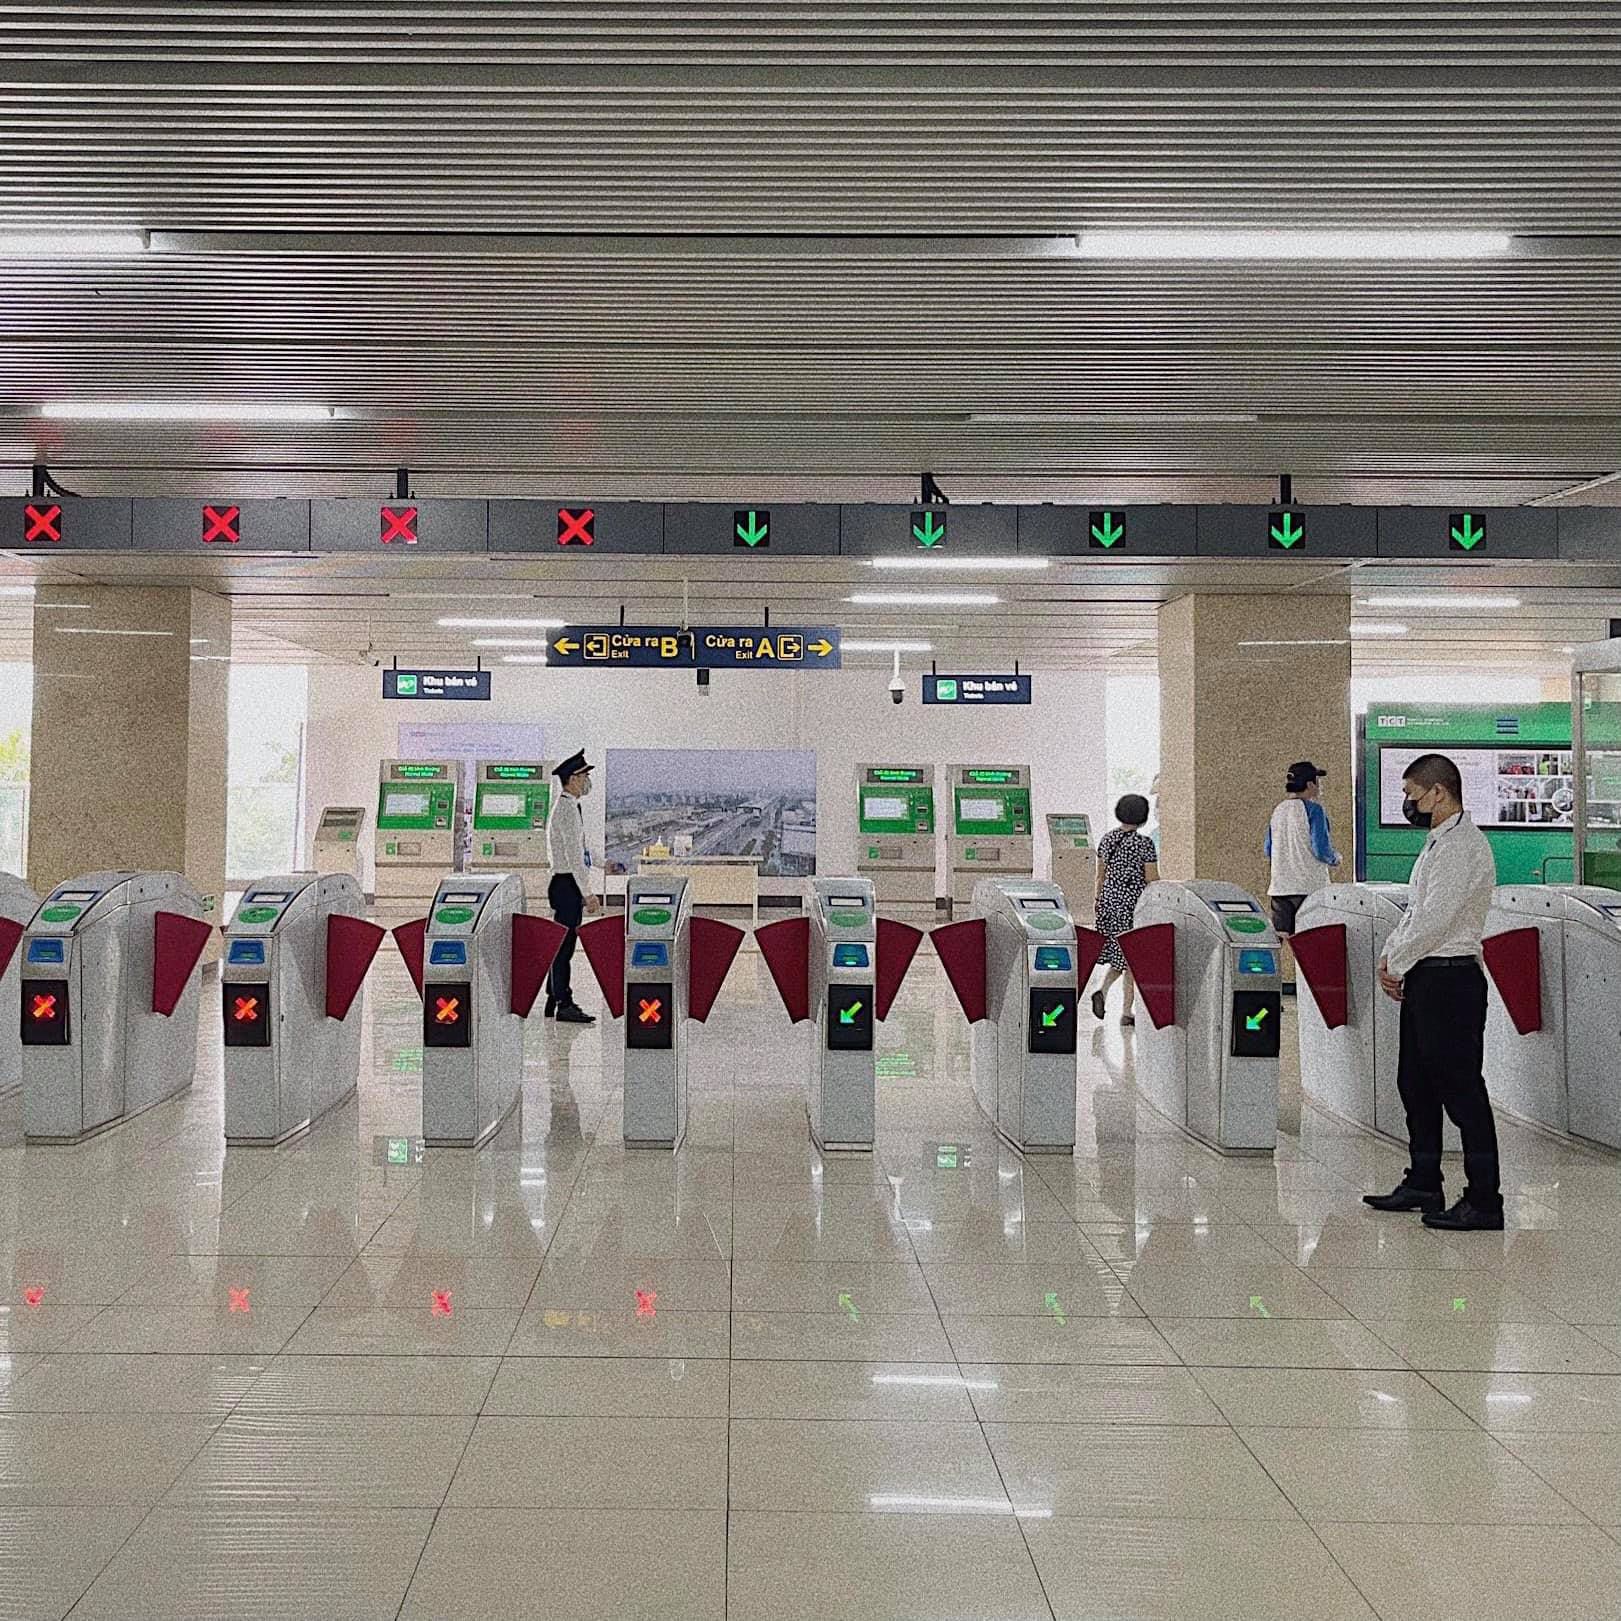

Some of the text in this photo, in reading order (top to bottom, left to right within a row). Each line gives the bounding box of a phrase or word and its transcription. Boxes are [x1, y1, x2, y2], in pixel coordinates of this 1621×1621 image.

[612, 634, 658, 646] Cửa ra
[705, 634, 753, 647] Cửa ra
[661, 637, 678, 657] B
[755, 637, 775, 658] A
[611, 650, 629, 658] Exit
[735, 650, 753, 659] Exit
